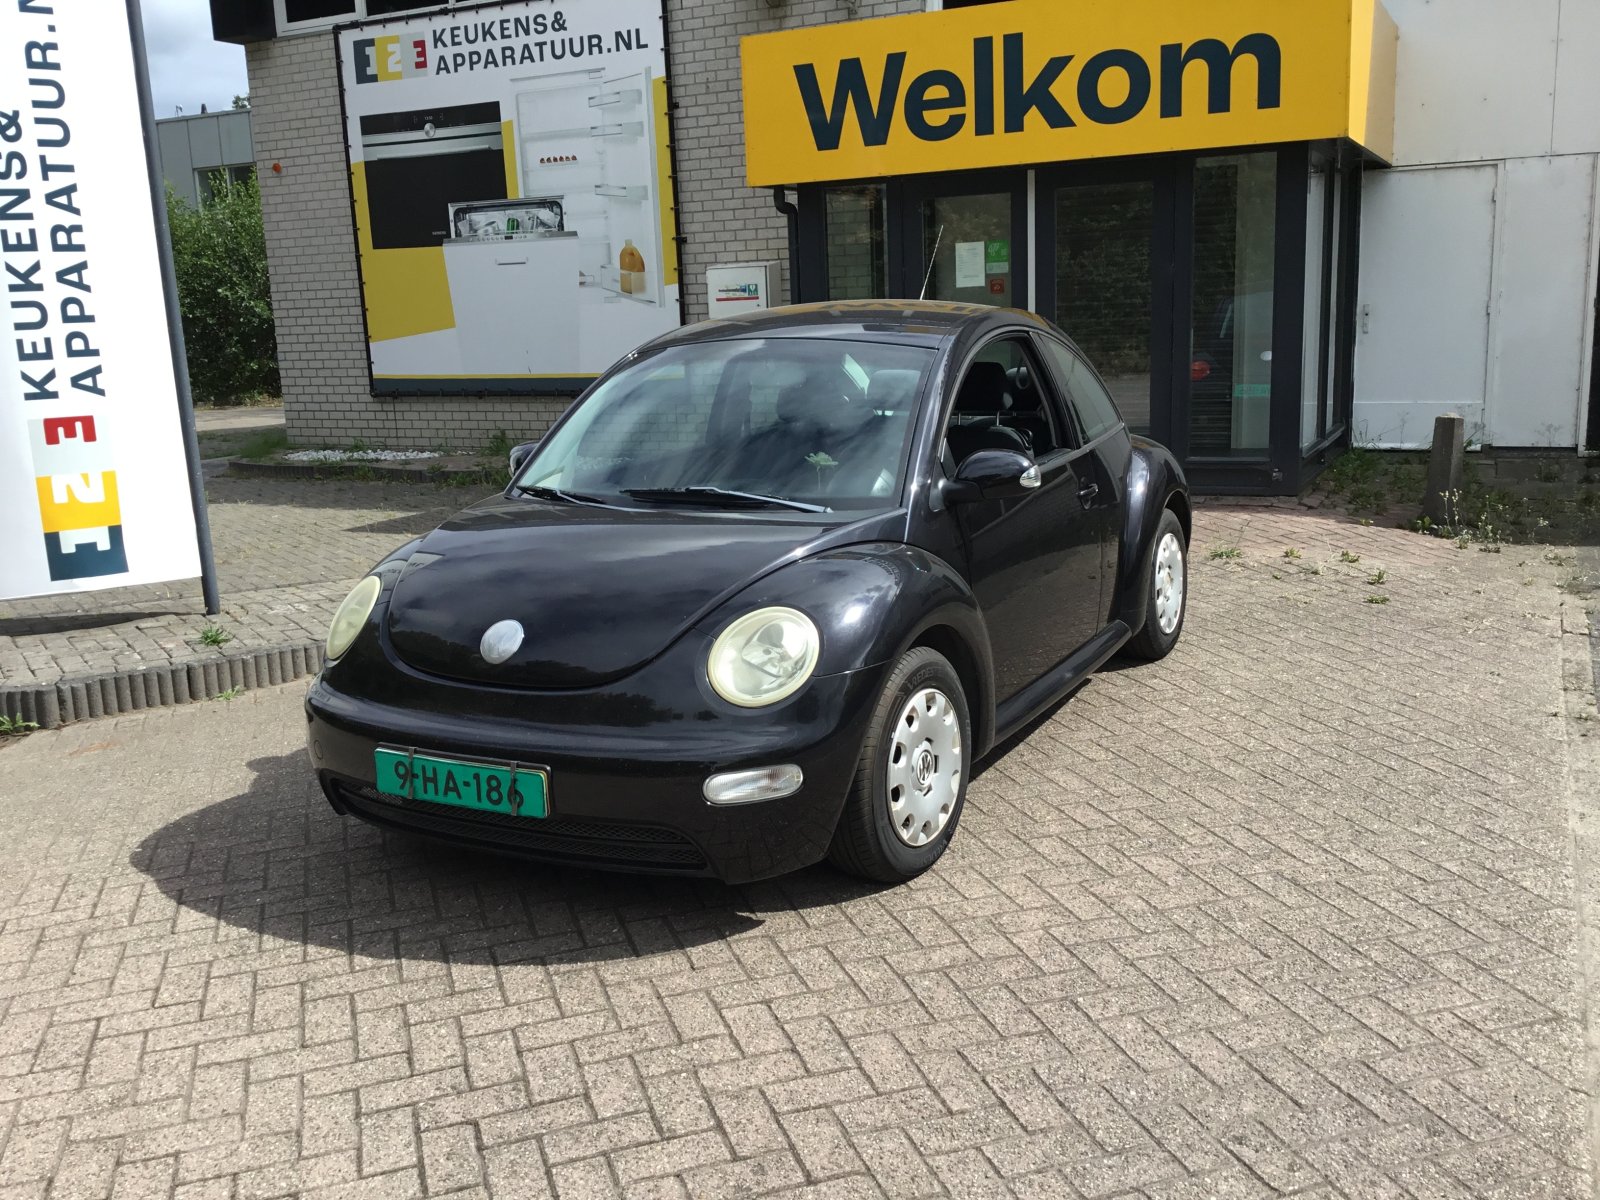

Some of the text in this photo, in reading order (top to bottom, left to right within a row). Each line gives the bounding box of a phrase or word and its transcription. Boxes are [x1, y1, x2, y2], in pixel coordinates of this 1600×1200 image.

[433, 11, 568, 49] KEUKENS&
[436, 29, 649, 76] APPARATUUR.NL
[365, 38, 428, 76] 123
[793, 31, 1282, 152] Welkom
[0, 110, 60, 400] KEUKENS&
[394, 760, 525, 809] 9-HA-186
